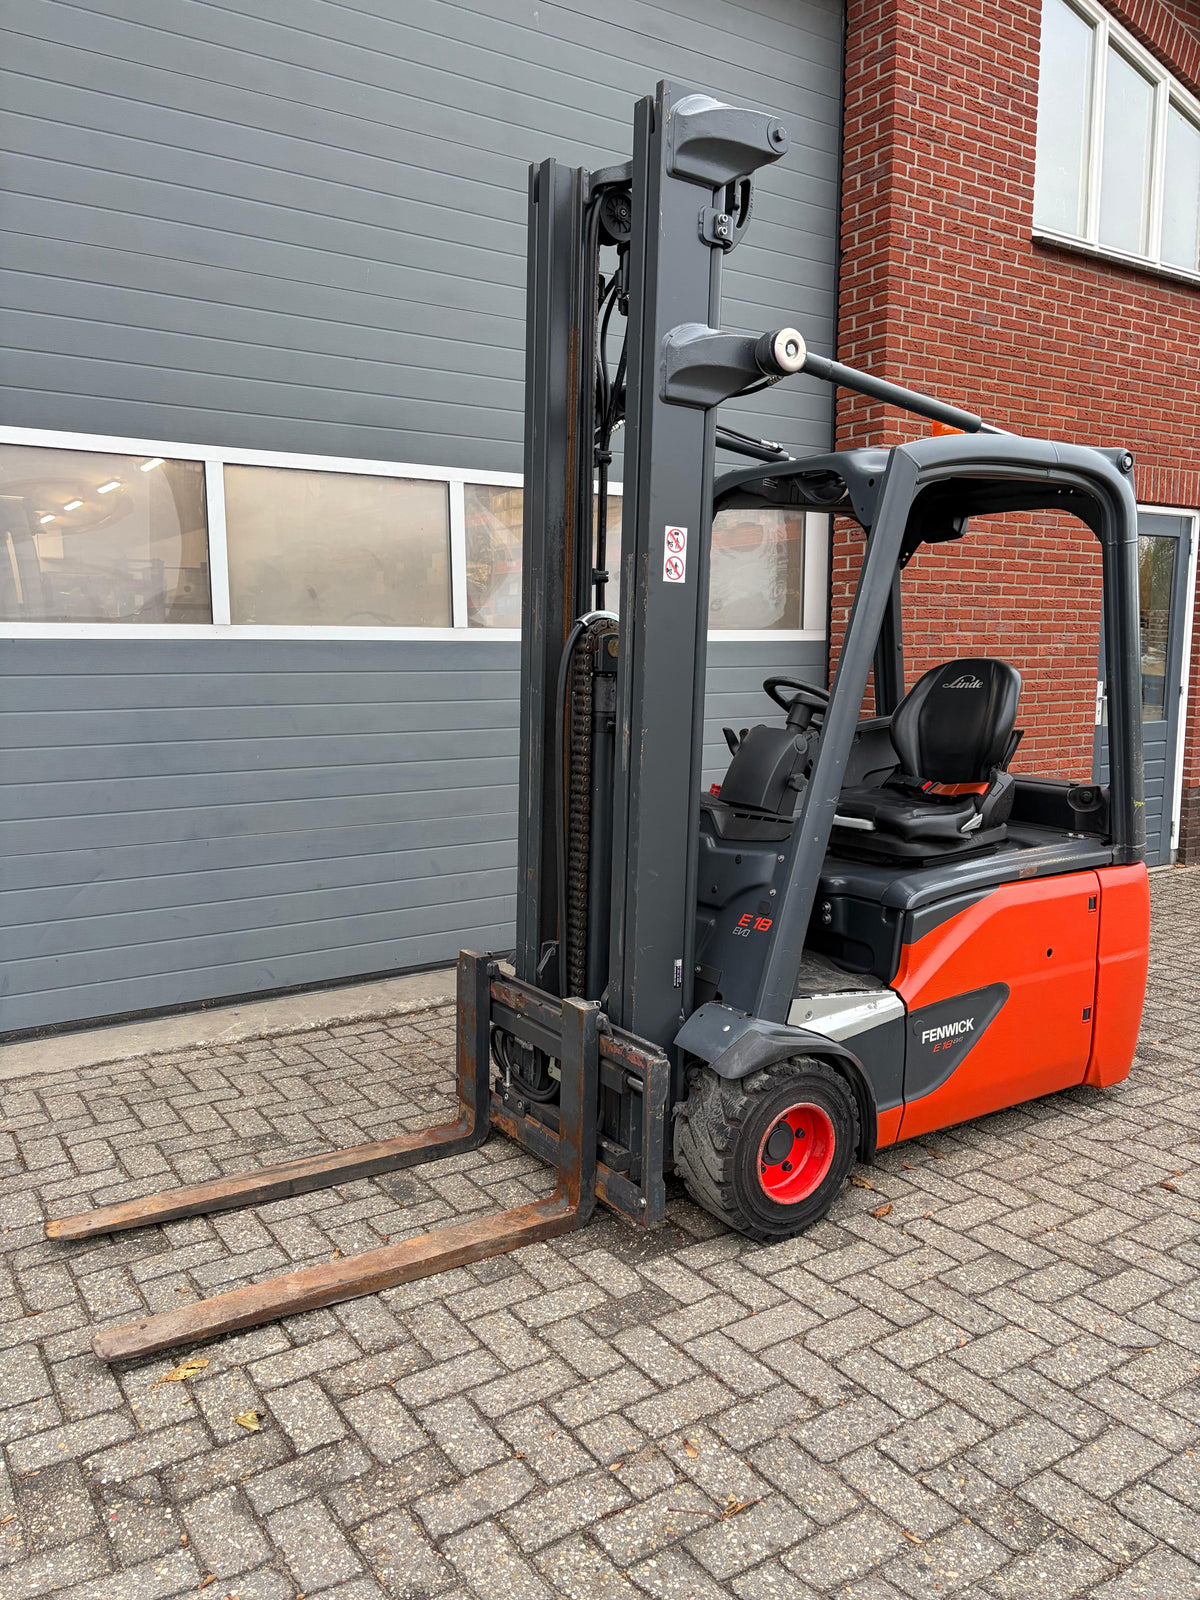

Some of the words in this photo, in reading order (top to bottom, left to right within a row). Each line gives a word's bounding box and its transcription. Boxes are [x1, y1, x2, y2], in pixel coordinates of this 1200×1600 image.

[942, 675, 983, 688] Linde
[732, 927, 750, 937] EVO
[922, 1018, 974, 1044] FENWICK
